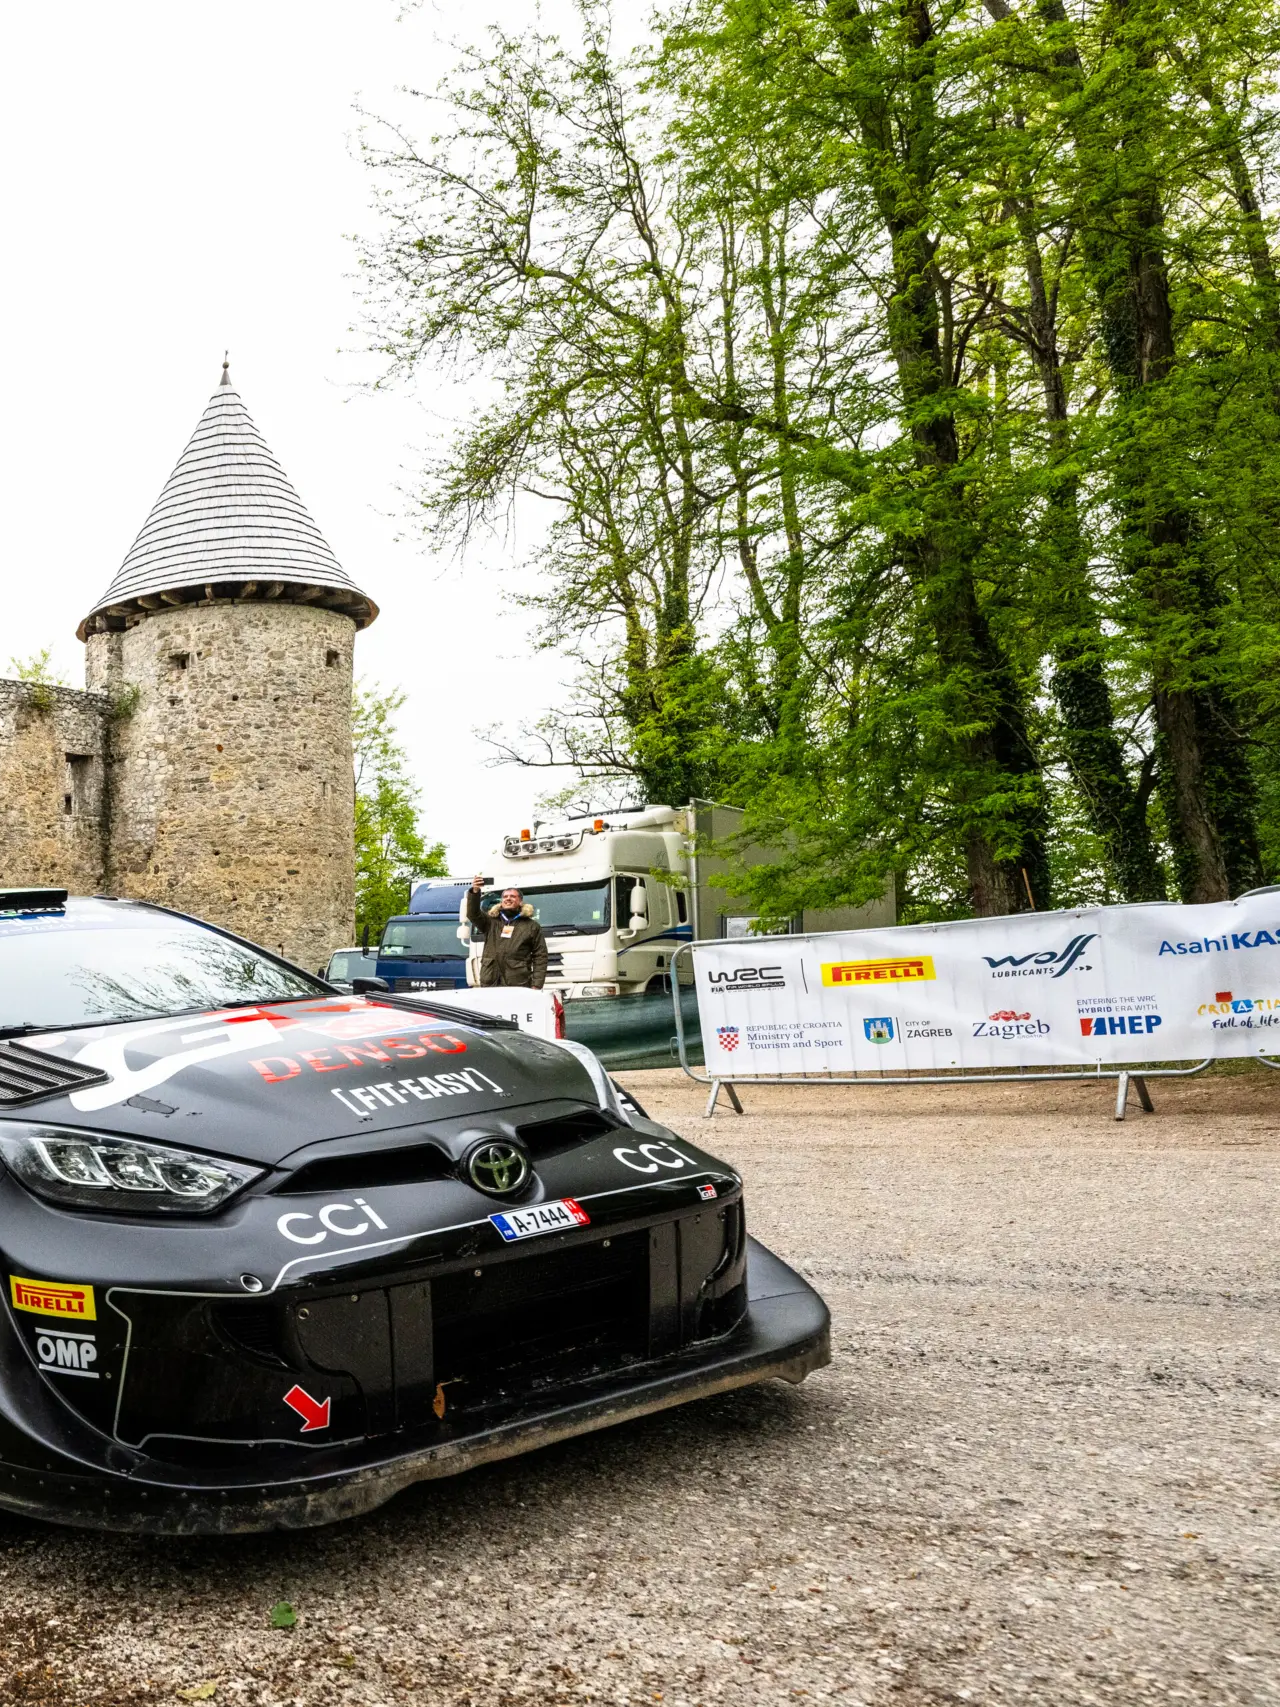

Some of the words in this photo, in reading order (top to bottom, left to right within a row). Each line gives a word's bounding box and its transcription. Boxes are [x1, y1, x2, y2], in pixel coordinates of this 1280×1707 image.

[708, 967, 784, 983] WRC
[831, 961, 924, 982] PIRELLI
[991, 967, 1055, 979] LUBRICANTS
[1076, 997, 1118, 1006] ENTERING
[1119, 996, 1136, 1004] THE
[1137, 995, 1156, 1003] WRC
[1078, 1006, 1112, 1014] HYBRID
[1115, 1005, 1133, 1013] ERA
[1134, 1004, 1158, 1012] WITH
[746, 1023, 788, 1032] REPUBLIC
[802, 1021, 842, 1029] CROATIA
[1108, 1015, 1162, 1036] HEP
[1212, 1017, 1238, 1028] Full
[907, 1028, 952, 1039] ZAGREB
[972, 1019, 1050, 1039] Zagreb
[747, 1032, 795, 1042] Ministry
[796, 1031, 804, 1039] of
[747, 1040, 791, 1050] Tourism
[793, 1039, 812, 1048] and
[814, 1038, 843, 1049] Sport
[248, 1033, 467, 1084] DENSO
[701, 1190, 717, 1199] GR
[512, 1206, 571, 1233] A-7444
[574, 1213, 586, 1223] 24
[15, 1283, 85, 1313] PIRELLI
[37, 1336, 97, 1369] OMP
